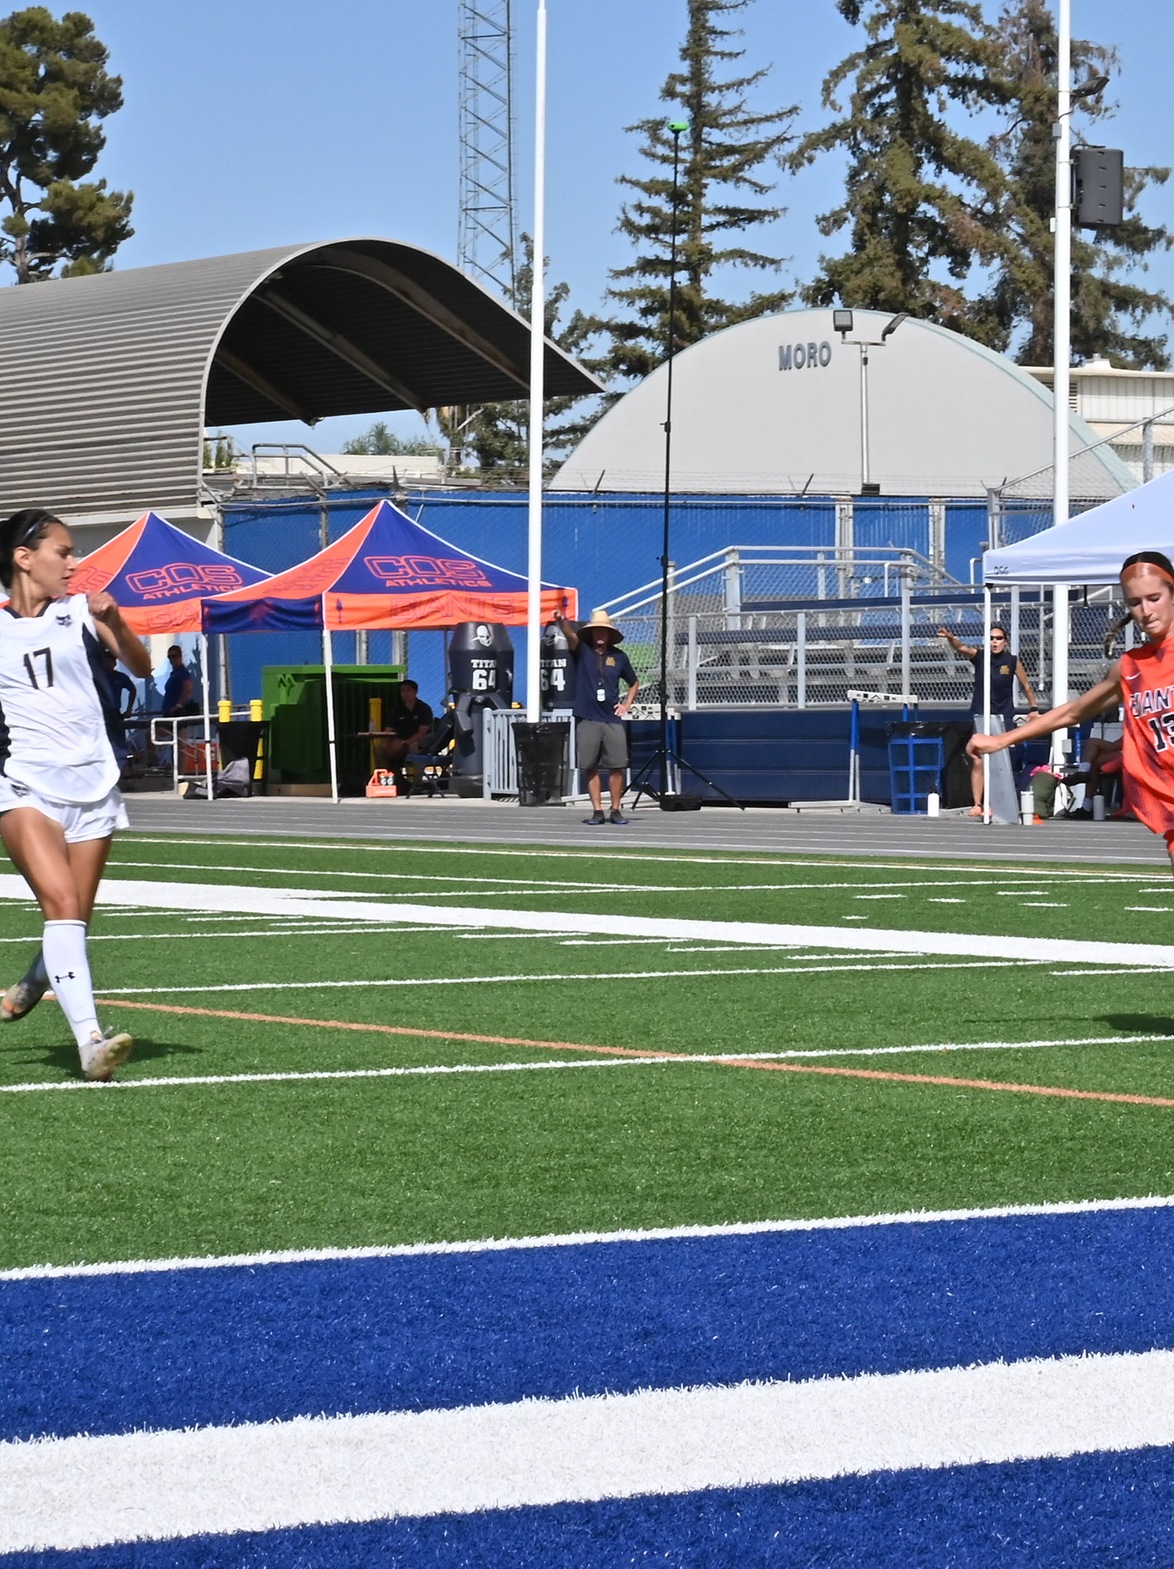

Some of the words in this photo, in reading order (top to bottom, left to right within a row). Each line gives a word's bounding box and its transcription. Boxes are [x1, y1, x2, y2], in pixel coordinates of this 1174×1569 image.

[778, 341, 832, 371] MORO
[125, 562, 243, 593] COS
[363, 555, 486, 580] COS
[385, 578, 492, 587] ATHLETICS
[23, 646, 54, 690] 17
[472, 669, 496, 690] 64
[540, 668, 566, 691] 64
